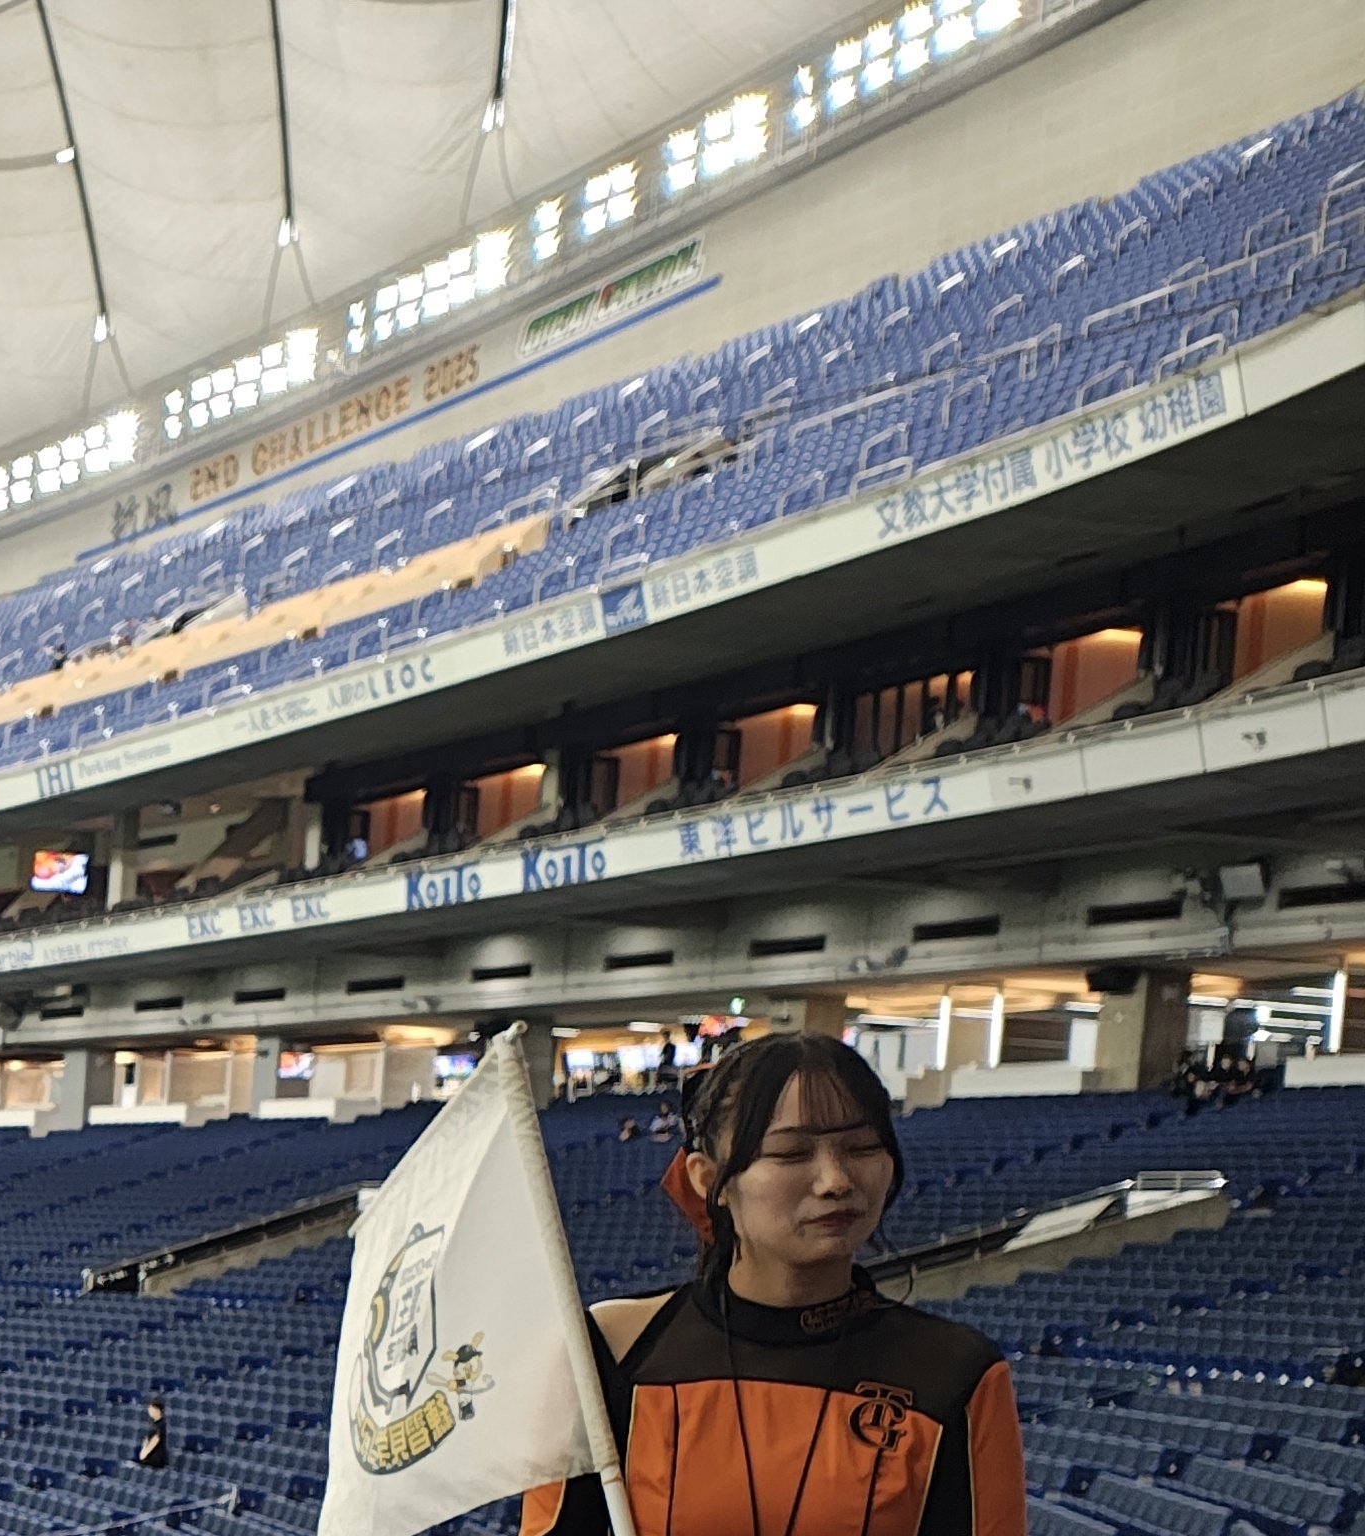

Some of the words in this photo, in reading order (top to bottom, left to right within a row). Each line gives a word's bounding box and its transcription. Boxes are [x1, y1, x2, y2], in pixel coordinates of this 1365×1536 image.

[1044, 411, 1132, 481] 小学校
[35, 761, 77, 798] IHI
[680, 776, 949, 858] 東洋ビルサービス
